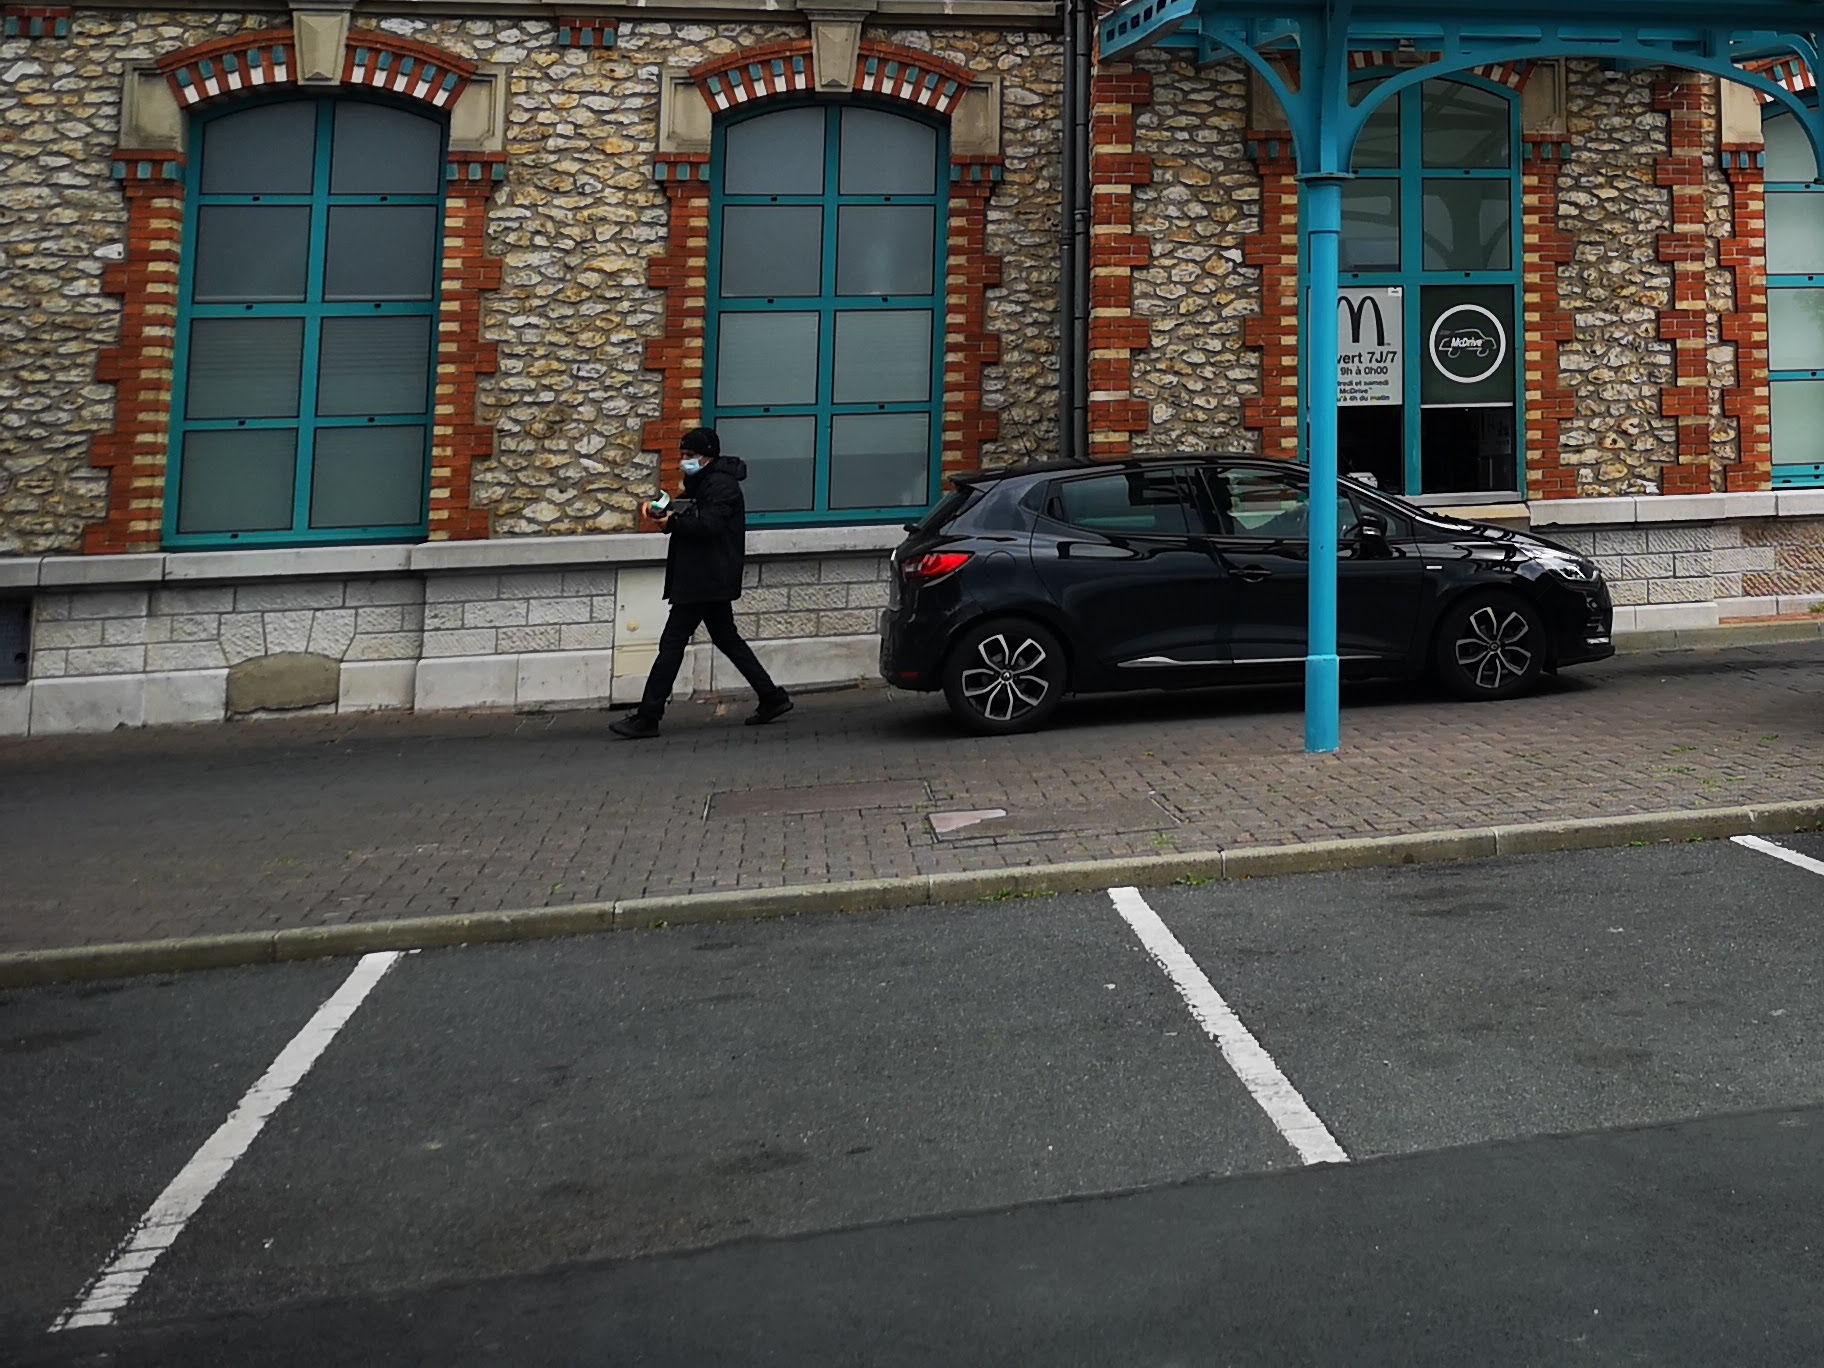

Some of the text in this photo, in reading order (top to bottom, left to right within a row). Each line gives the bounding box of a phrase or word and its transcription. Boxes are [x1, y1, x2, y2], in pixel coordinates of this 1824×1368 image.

[1337, 351, 1397, 364] vert 7J/7
[1340, 366, 1353, 376] 9h
[1364, 366, 1388, 375] 0h00
